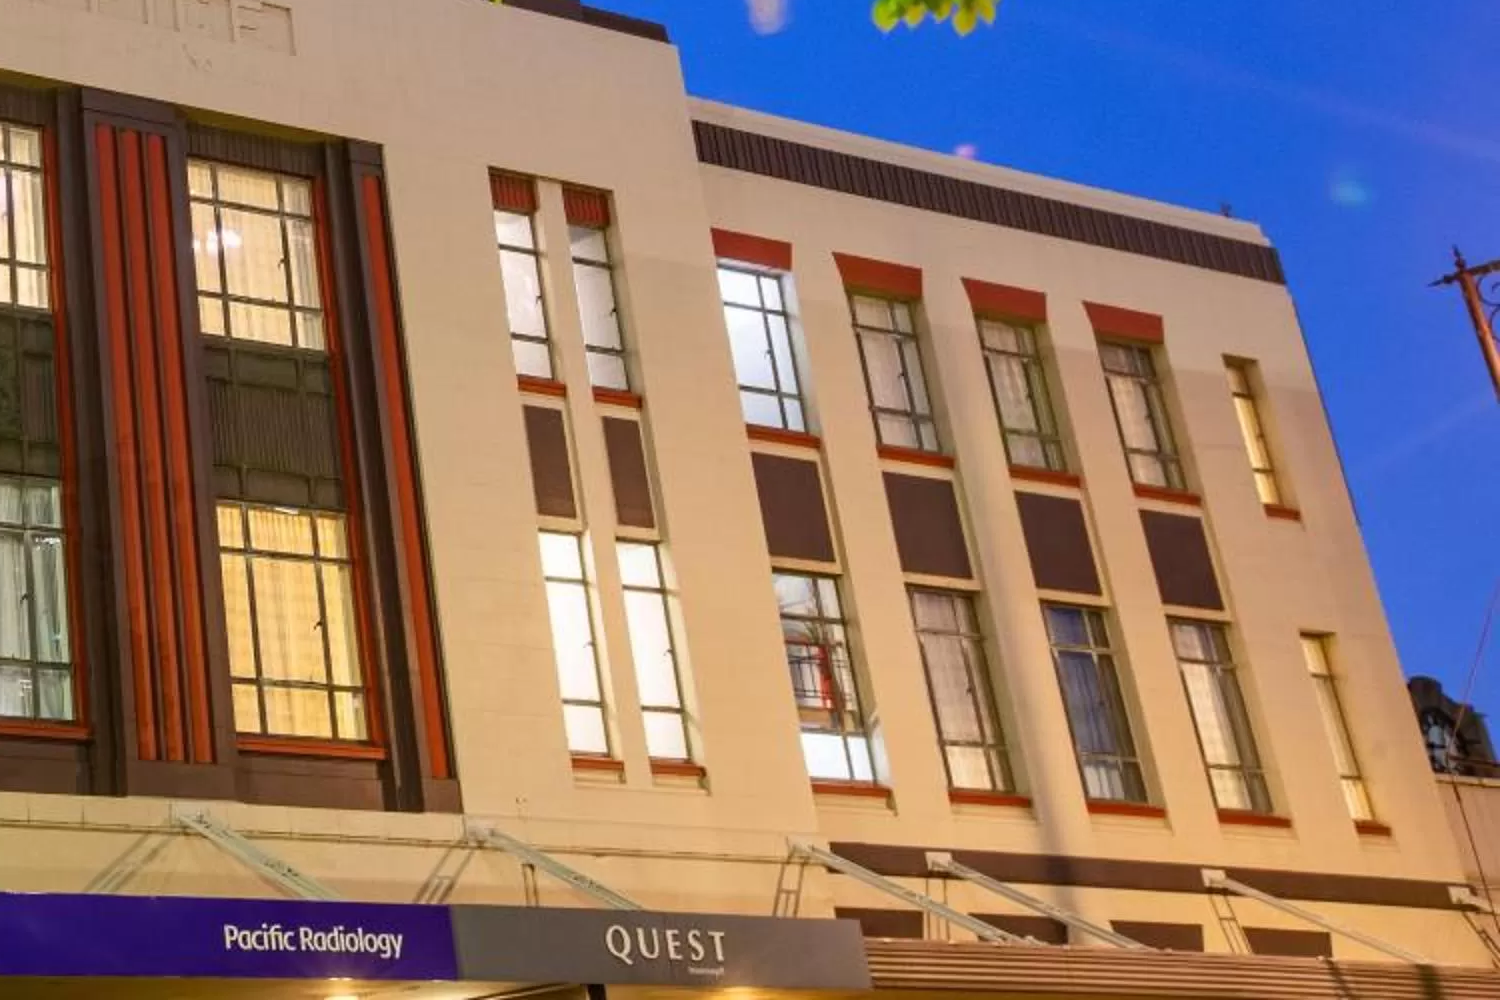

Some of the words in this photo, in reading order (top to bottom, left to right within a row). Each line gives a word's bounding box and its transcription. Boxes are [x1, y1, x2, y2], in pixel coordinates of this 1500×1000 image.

[223, 923, 297, 951] Pacific
[299, 925, 403, 960] Radiology
[605, 924, 725, 965] QUEST
